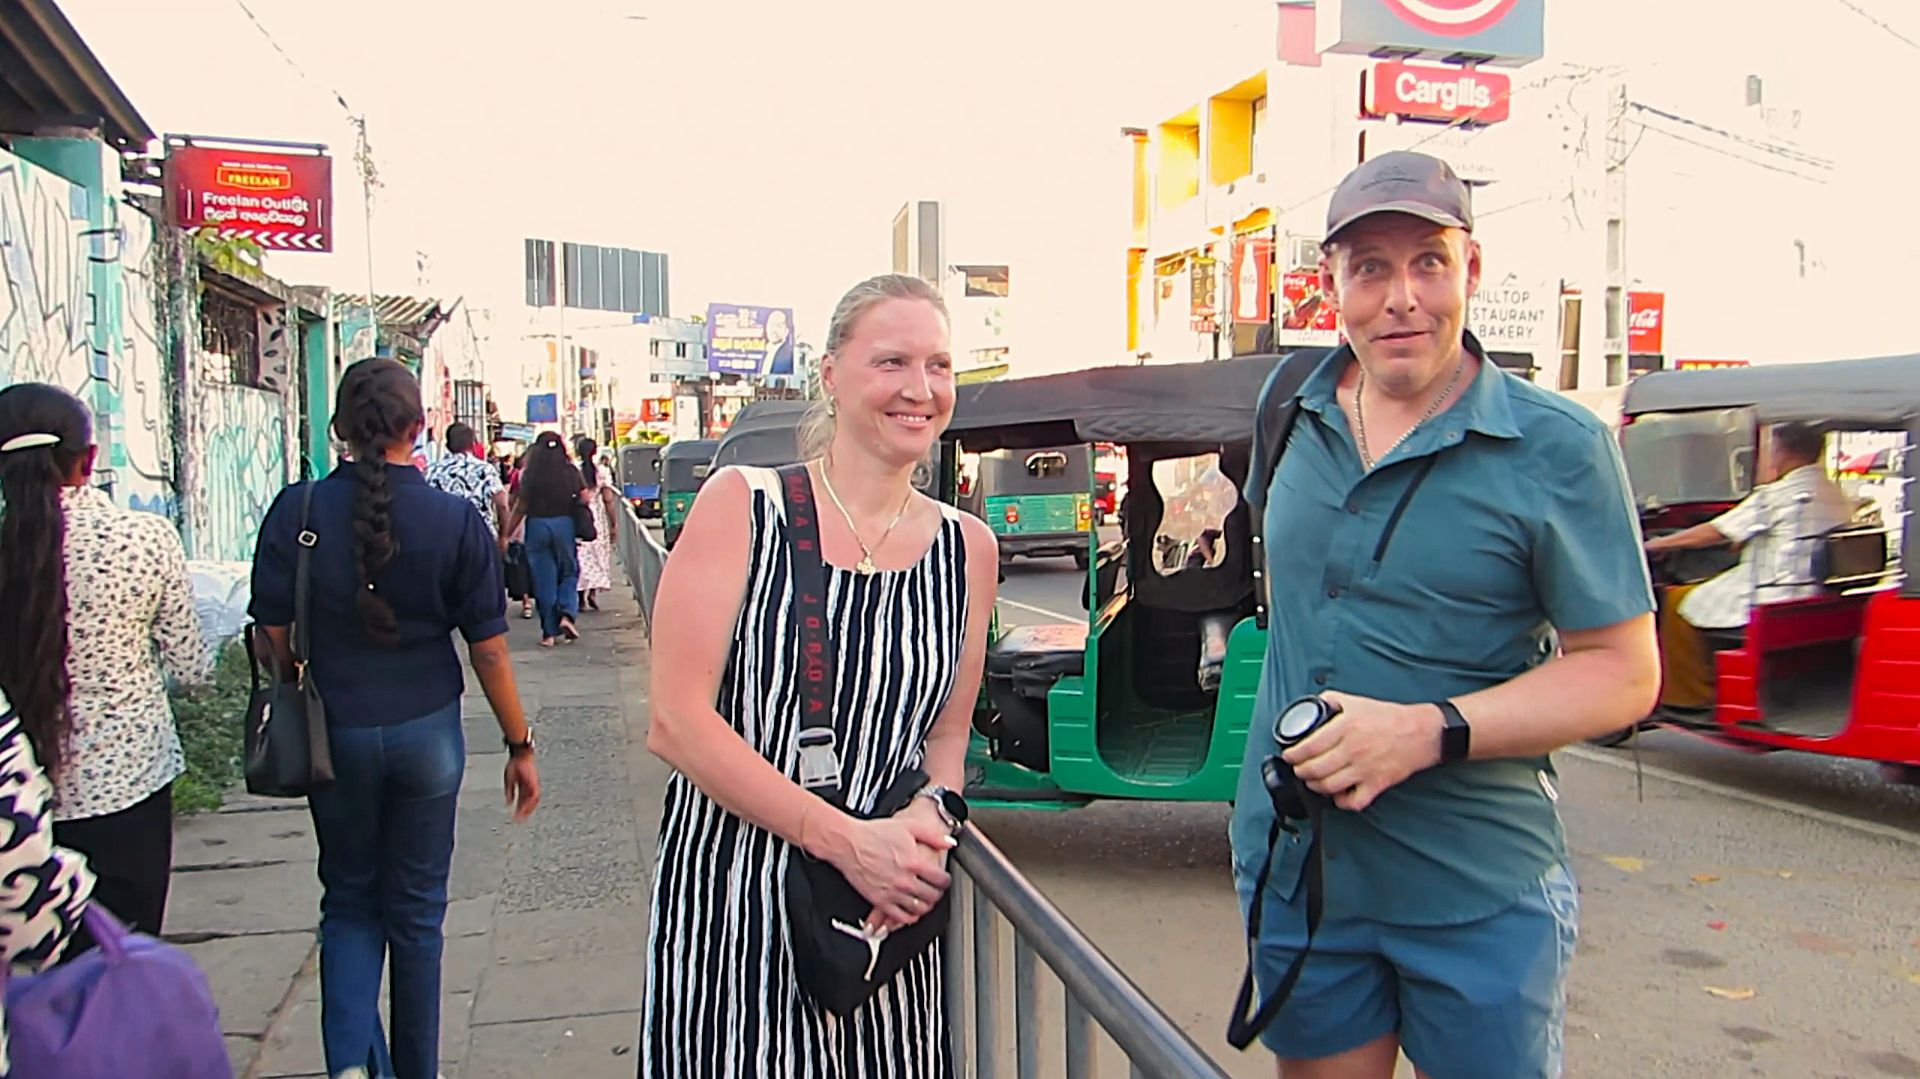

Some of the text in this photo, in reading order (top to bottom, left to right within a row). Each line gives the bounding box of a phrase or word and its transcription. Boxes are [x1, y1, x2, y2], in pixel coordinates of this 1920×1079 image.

[1395, 72, 1490, 112] Cargills
[228, 174, 280, 187] FREELAN
[202, 191, 260, 208] Freelan
[1472, 289, 1531, 305] HILLTOP
[1472, 306, 1545, 322] STAURANT
[1478, 324, 1535, 339] BAKERY
